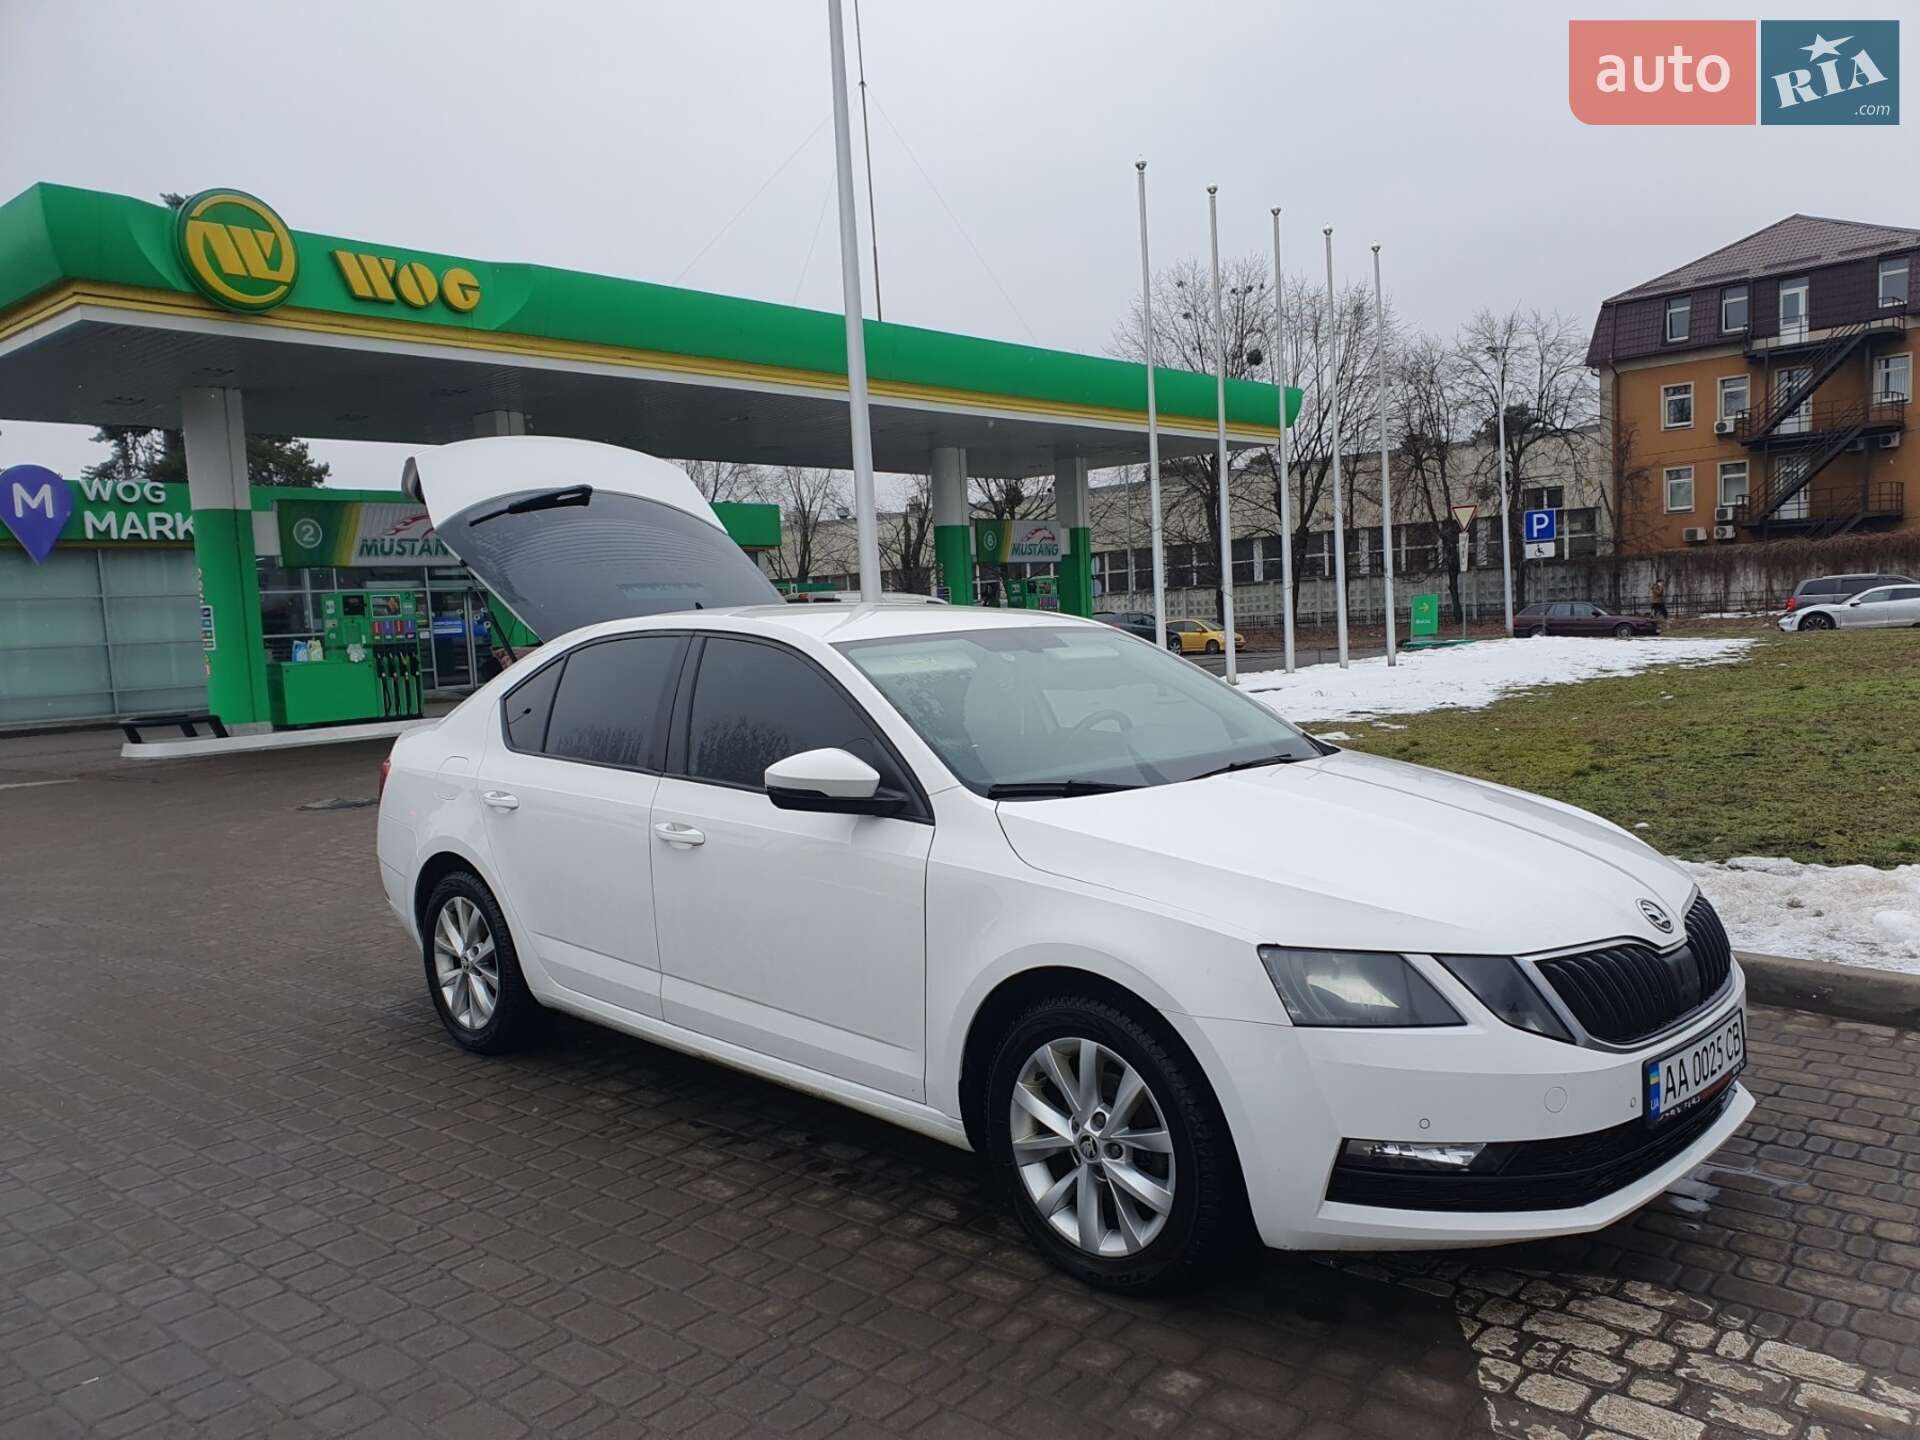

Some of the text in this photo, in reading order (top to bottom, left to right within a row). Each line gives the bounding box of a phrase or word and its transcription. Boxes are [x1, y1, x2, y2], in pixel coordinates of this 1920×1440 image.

[334, 249, 481, 313] WOG
[12, 482, 54, 518] M
[79, 478, 166, 503] WOG
[83, 510, 195, 540] MARK
[302, 525, 315, 542] 2
[1532, 513, 1549, 537] P
[1011, 543, 1059, 556] MUSTANG
[1664, 1022, 1741, 1104] AA 0025 CB
